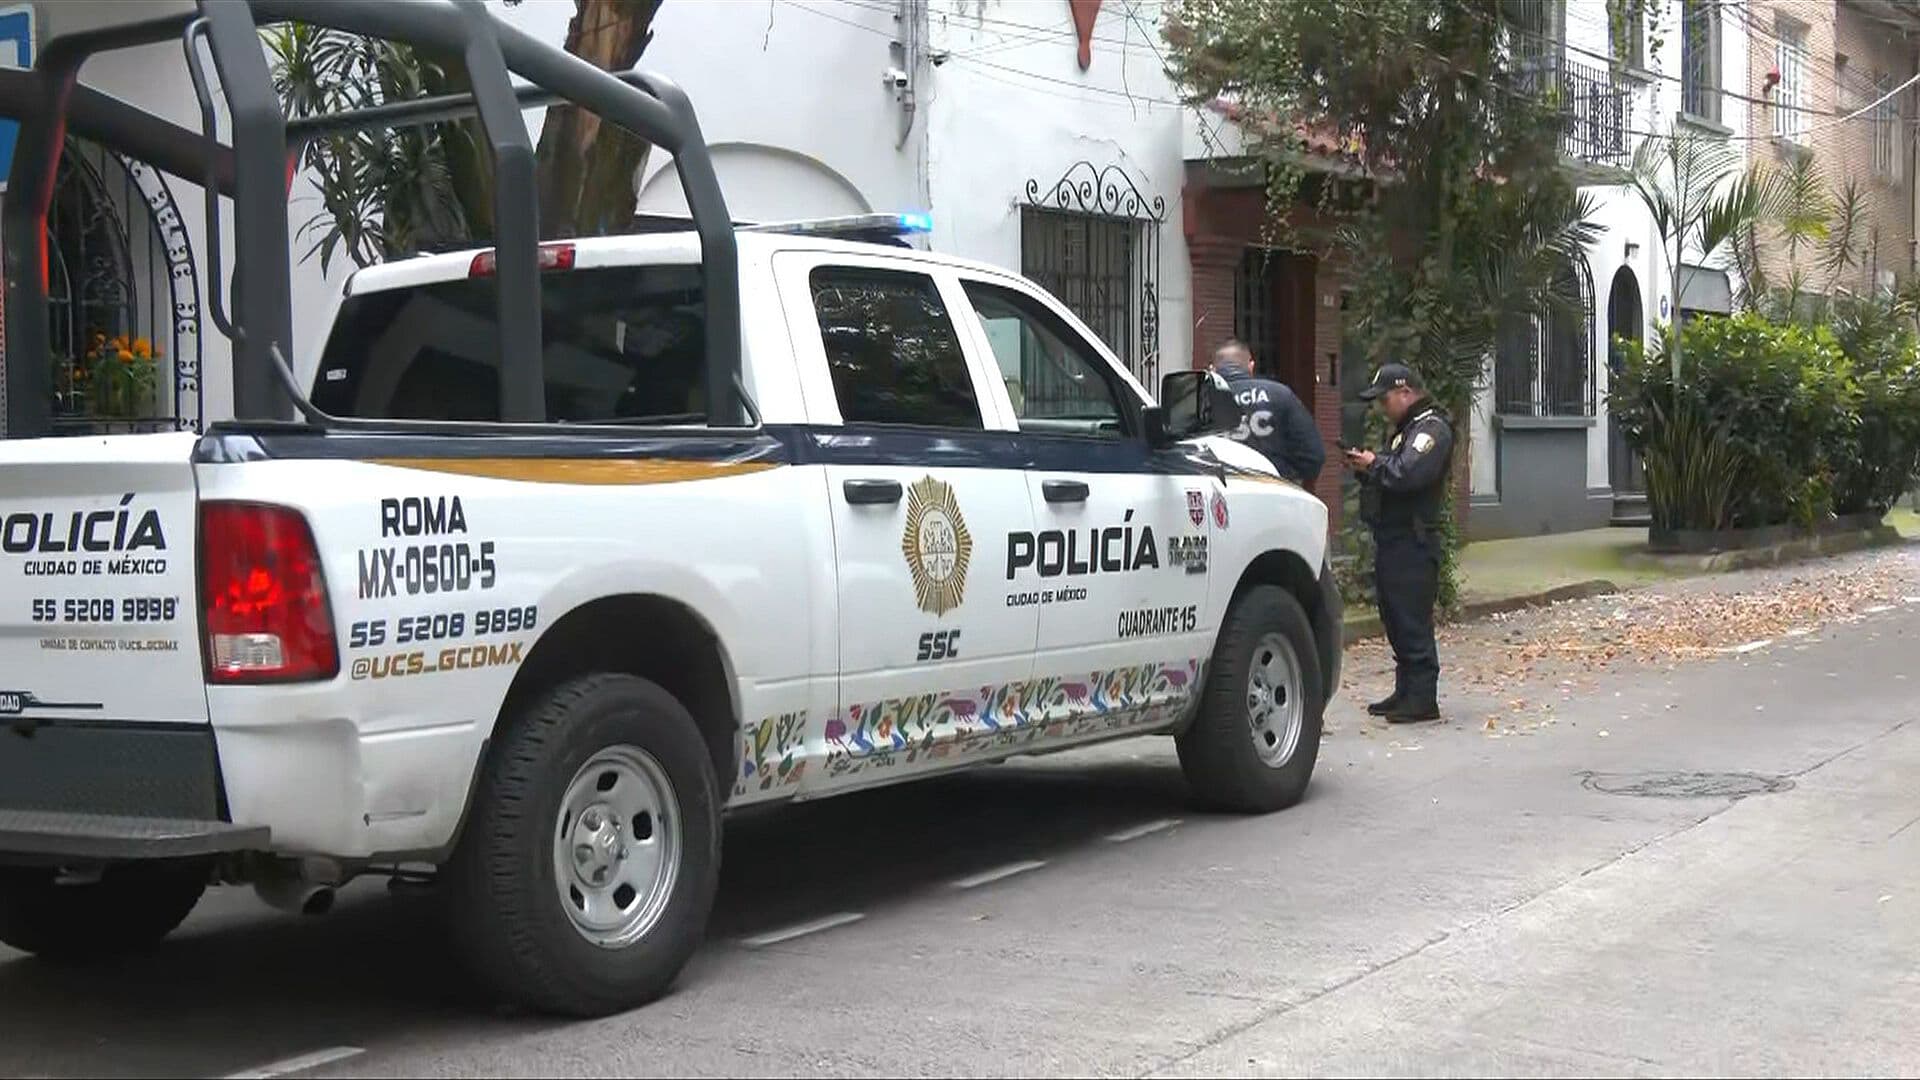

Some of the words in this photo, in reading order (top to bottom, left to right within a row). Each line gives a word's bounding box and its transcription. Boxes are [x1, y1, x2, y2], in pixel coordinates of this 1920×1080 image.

[1234, 387, 1270, 406] ICÍA
[0, 492, 166, 553] OLICÍA
[381, 495, 468, 538] ROMA
[1006, 508, 1159, 580] POLICÍA
[24, 560, 77, 576] CIUDAD
[82, 560, 103, 575] DE
[108, 554, 167, 575] MÉXICO
[32, 598, 56, 622] 55
[64, 598, 114, 622] 5208
[121, 597, 176, 622] 9898
[1006, 592, 1039, 607] CIUDAD
[1042, 591, 1054, 603] DE
[1056, 585, 1087, 602] MÉXICO
[349, 619, 386, 649] 55
[396, 612, 465, 644] 5208
[474, 605, 537, 636] 9898
[1118, 607, 1178, 638] CUADRANTE
[1180, 605, 1197, 632] 15
[69, 639, 78, 650] DE
[351, 641, 524, 681] @UCS_GCDMX
[917, 629, 961, 662] SSC
